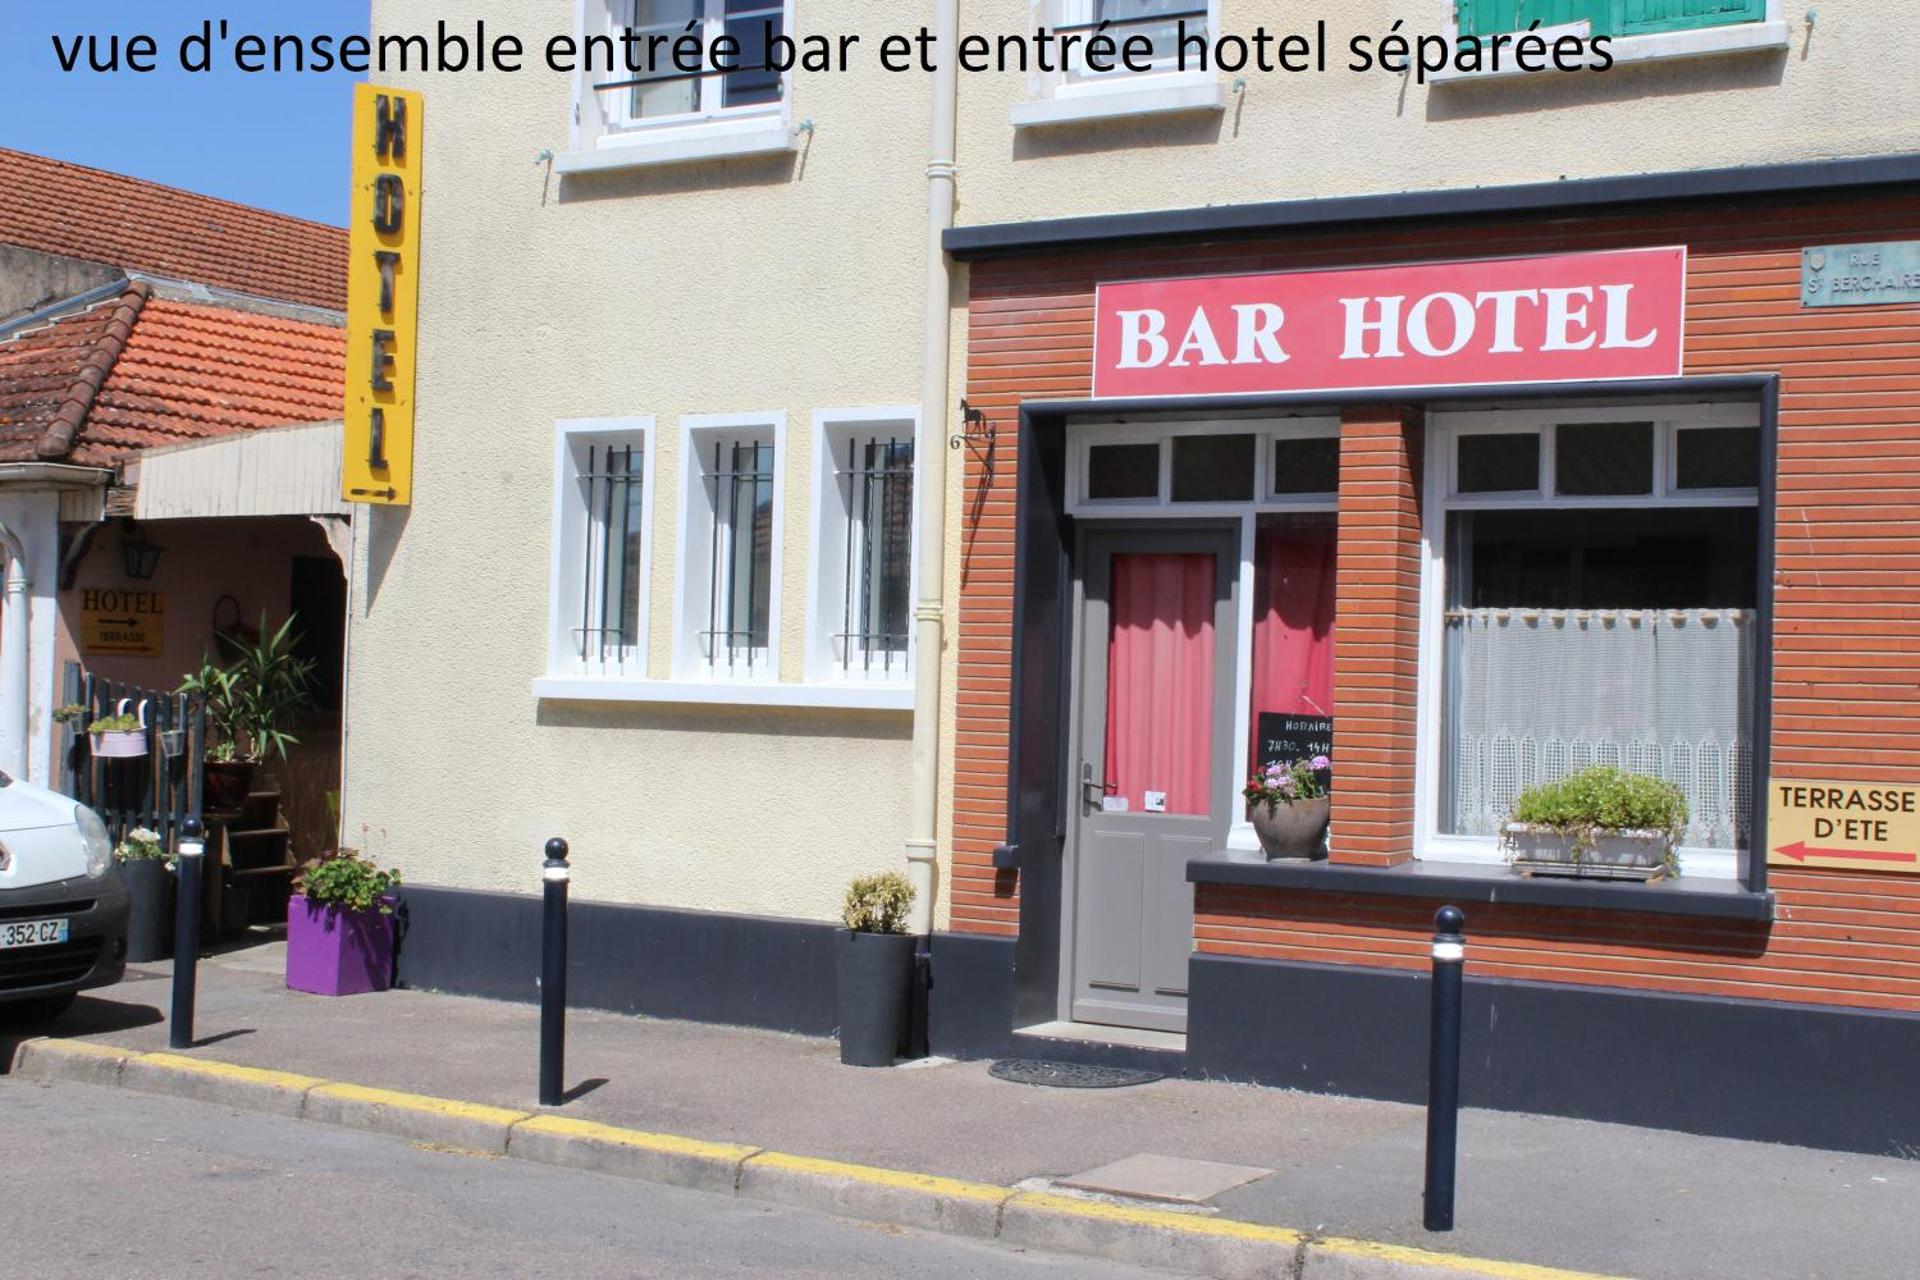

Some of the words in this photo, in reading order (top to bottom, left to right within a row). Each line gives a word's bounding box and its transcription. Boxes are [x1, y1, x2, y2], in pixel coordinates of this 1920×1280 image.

[1849, 253, 1881, 268] RUE
[368, 94, 407, 470] HOTEL
[1115, 303, 1291, 369] BAR
[1338, 283, 1658, 359] HOTEL
[82, 588, 163, 615] HOTEL
[99, 631, 146, 643] TERRASSE
[1779, 786, 1916, 813] TERRASSE
[1814, 817, 1889, 842] D'ETE
